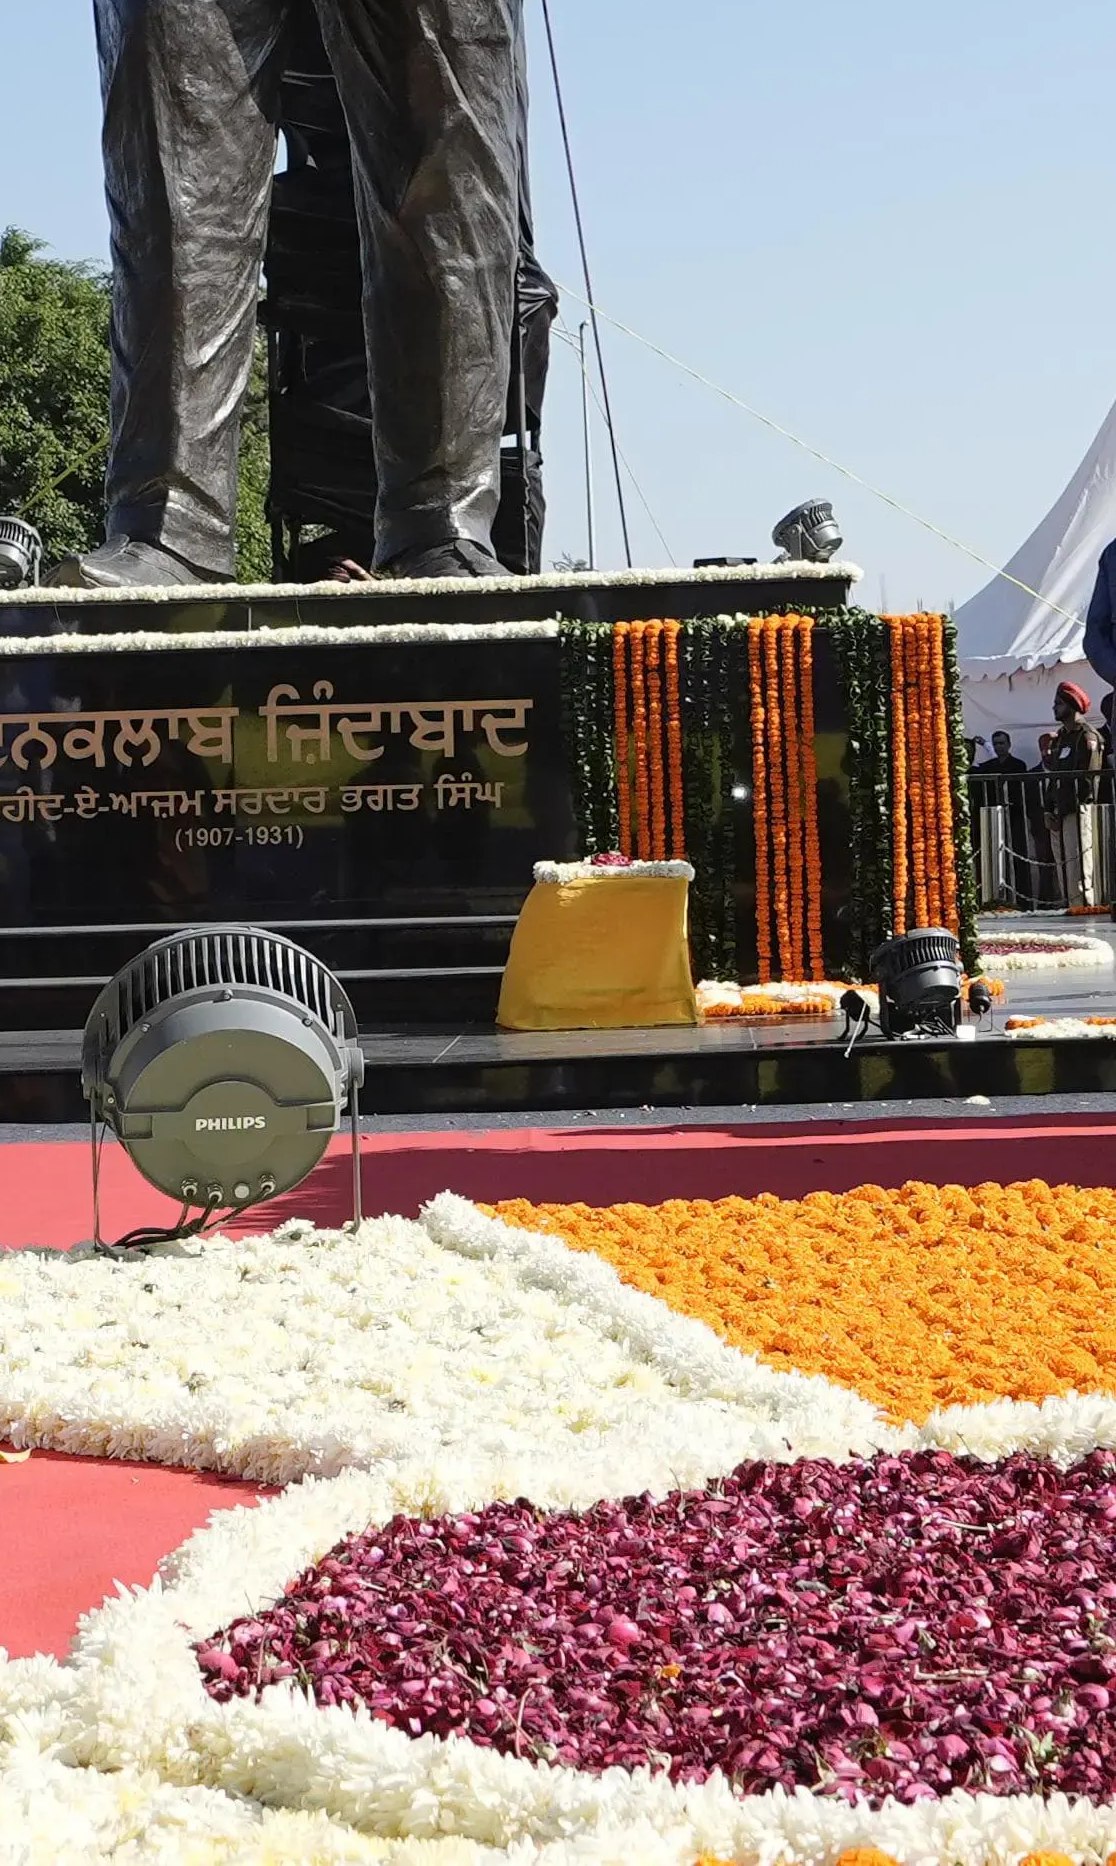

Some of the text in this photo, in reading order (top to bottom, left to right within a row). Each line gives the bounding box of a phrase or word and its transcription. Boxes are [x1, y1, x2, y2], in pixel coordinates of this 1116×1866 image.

[258, 679, 534, 763] ਜ਼ਿੰਦਾਬਾਦ
[211, 787, 328, 815] ਸਰਦਾਰ
[340, 784, 423, 813] ਭਗਤ
[434, 772, 504, 810] ਸਿੰਘ
[175, 826, 304, 852] (1907-1931)
[195, 1115, 266, 1132] PHILIPS
